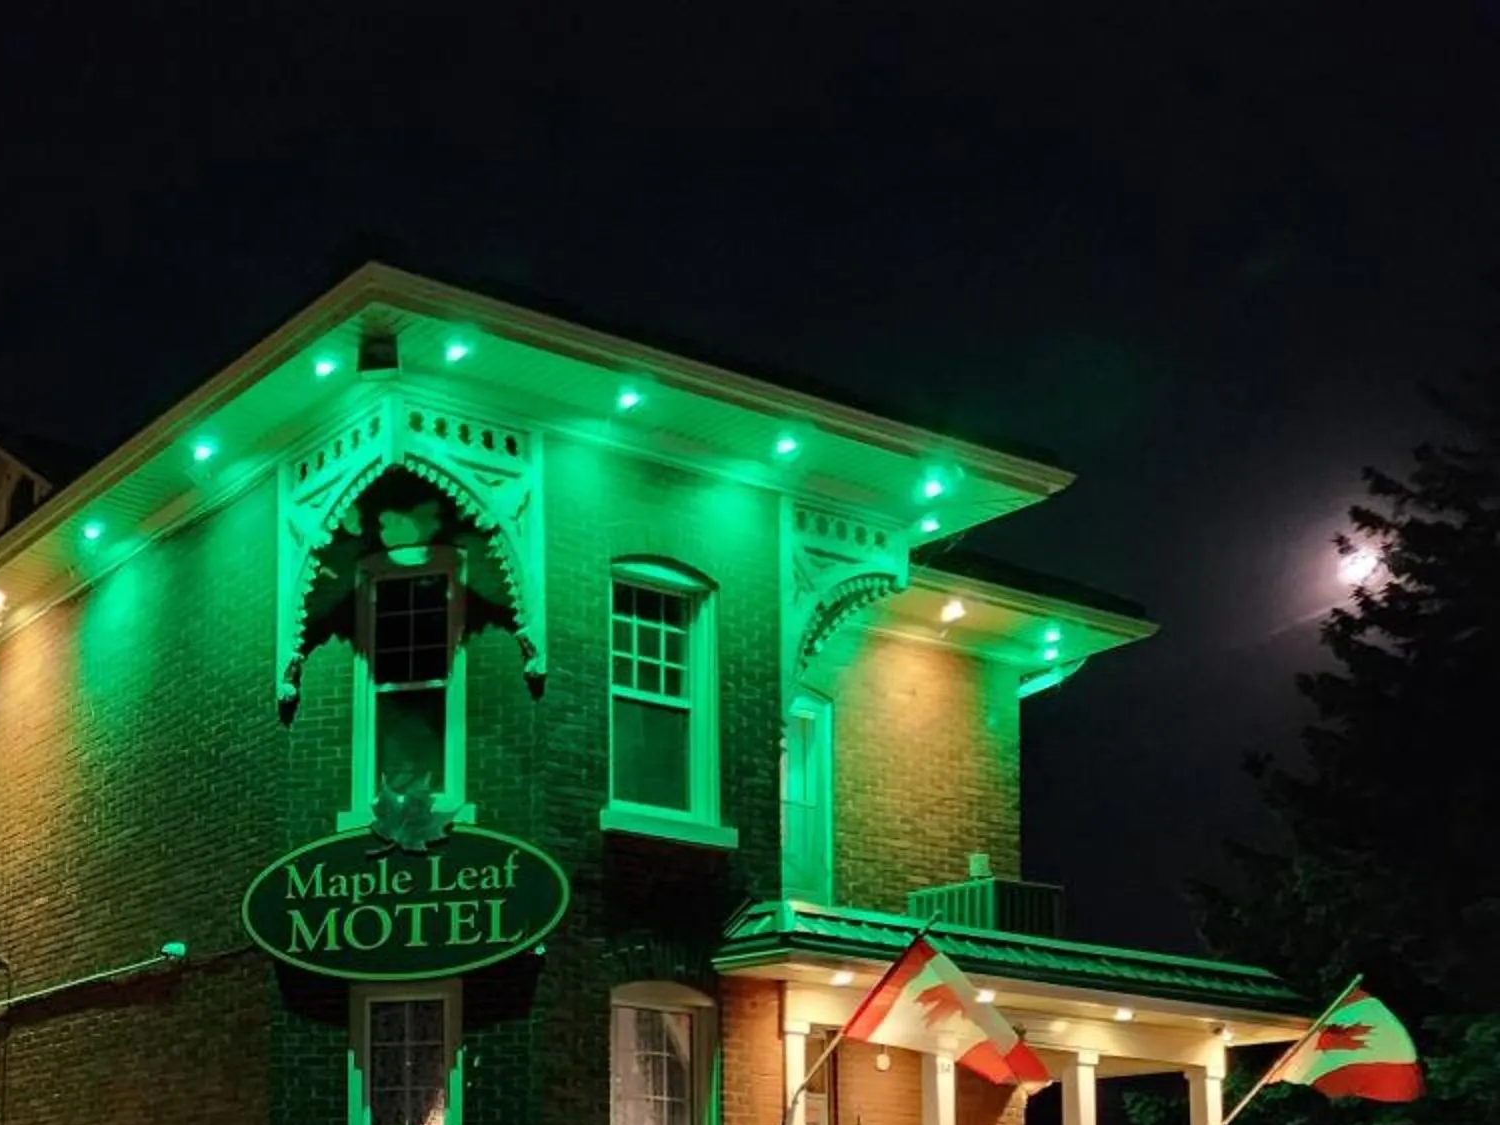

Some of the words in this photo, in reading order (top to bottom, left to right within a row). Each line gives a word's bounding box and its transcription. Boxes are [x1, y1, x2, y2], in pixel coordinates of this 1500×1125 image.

[284, 857, 413, 903] Maple
[428, 850, 520, 892] Leaf
[286, 900, 523, 953] MOTEL
